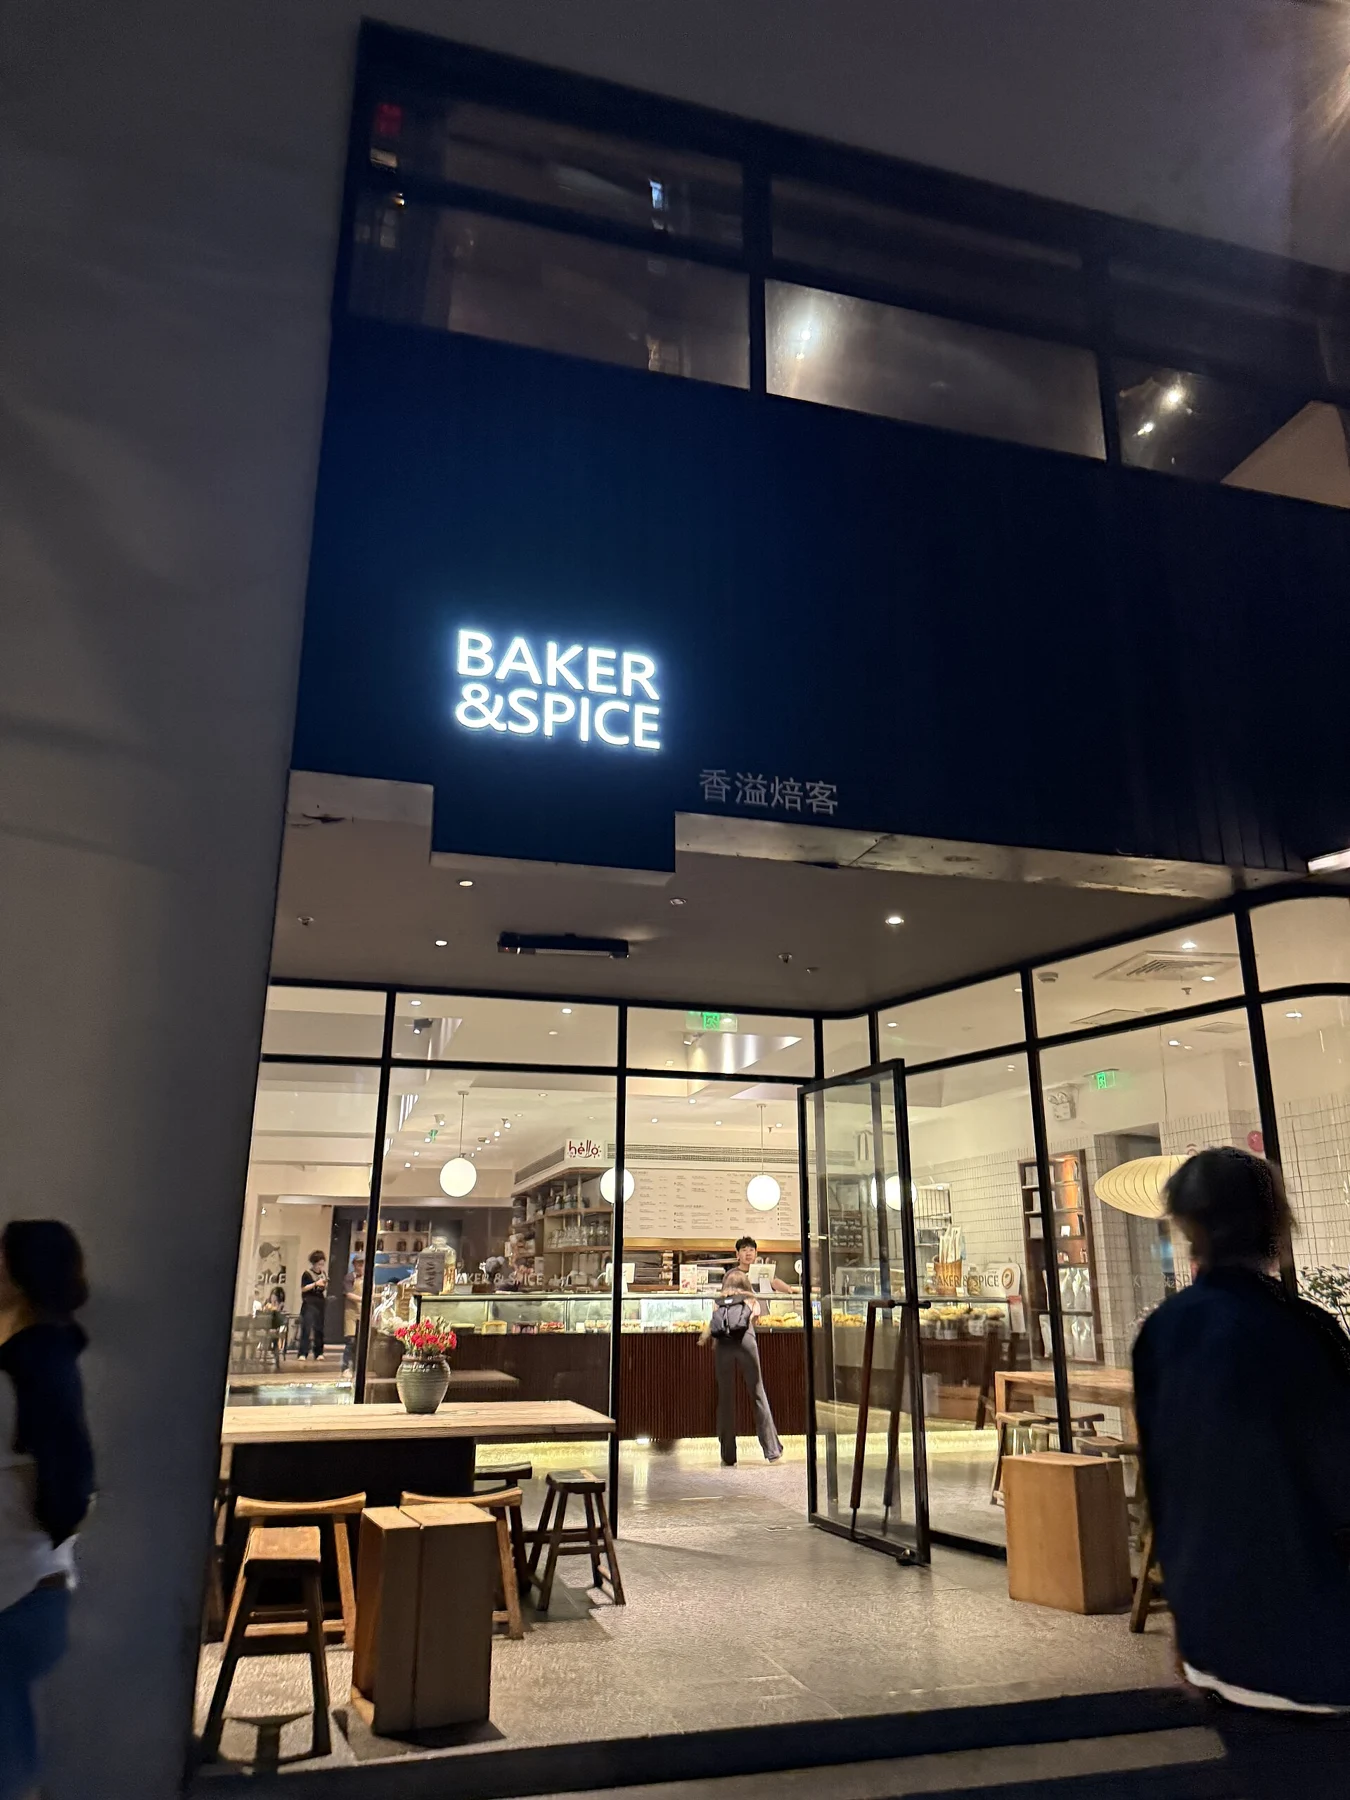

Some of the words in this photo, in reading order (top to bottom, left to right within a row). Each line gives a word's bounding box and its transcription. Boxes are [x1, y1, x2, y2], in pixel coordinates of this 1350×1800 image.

[457, 629, 660, 700] BAKER
[699, 769, 838, 816] 香溢焙客
[257, 1273, 286, 1284] PICE
[455, 1272, 490, 1285] AKER
[974, 1275, 999, 1287] SPICE
